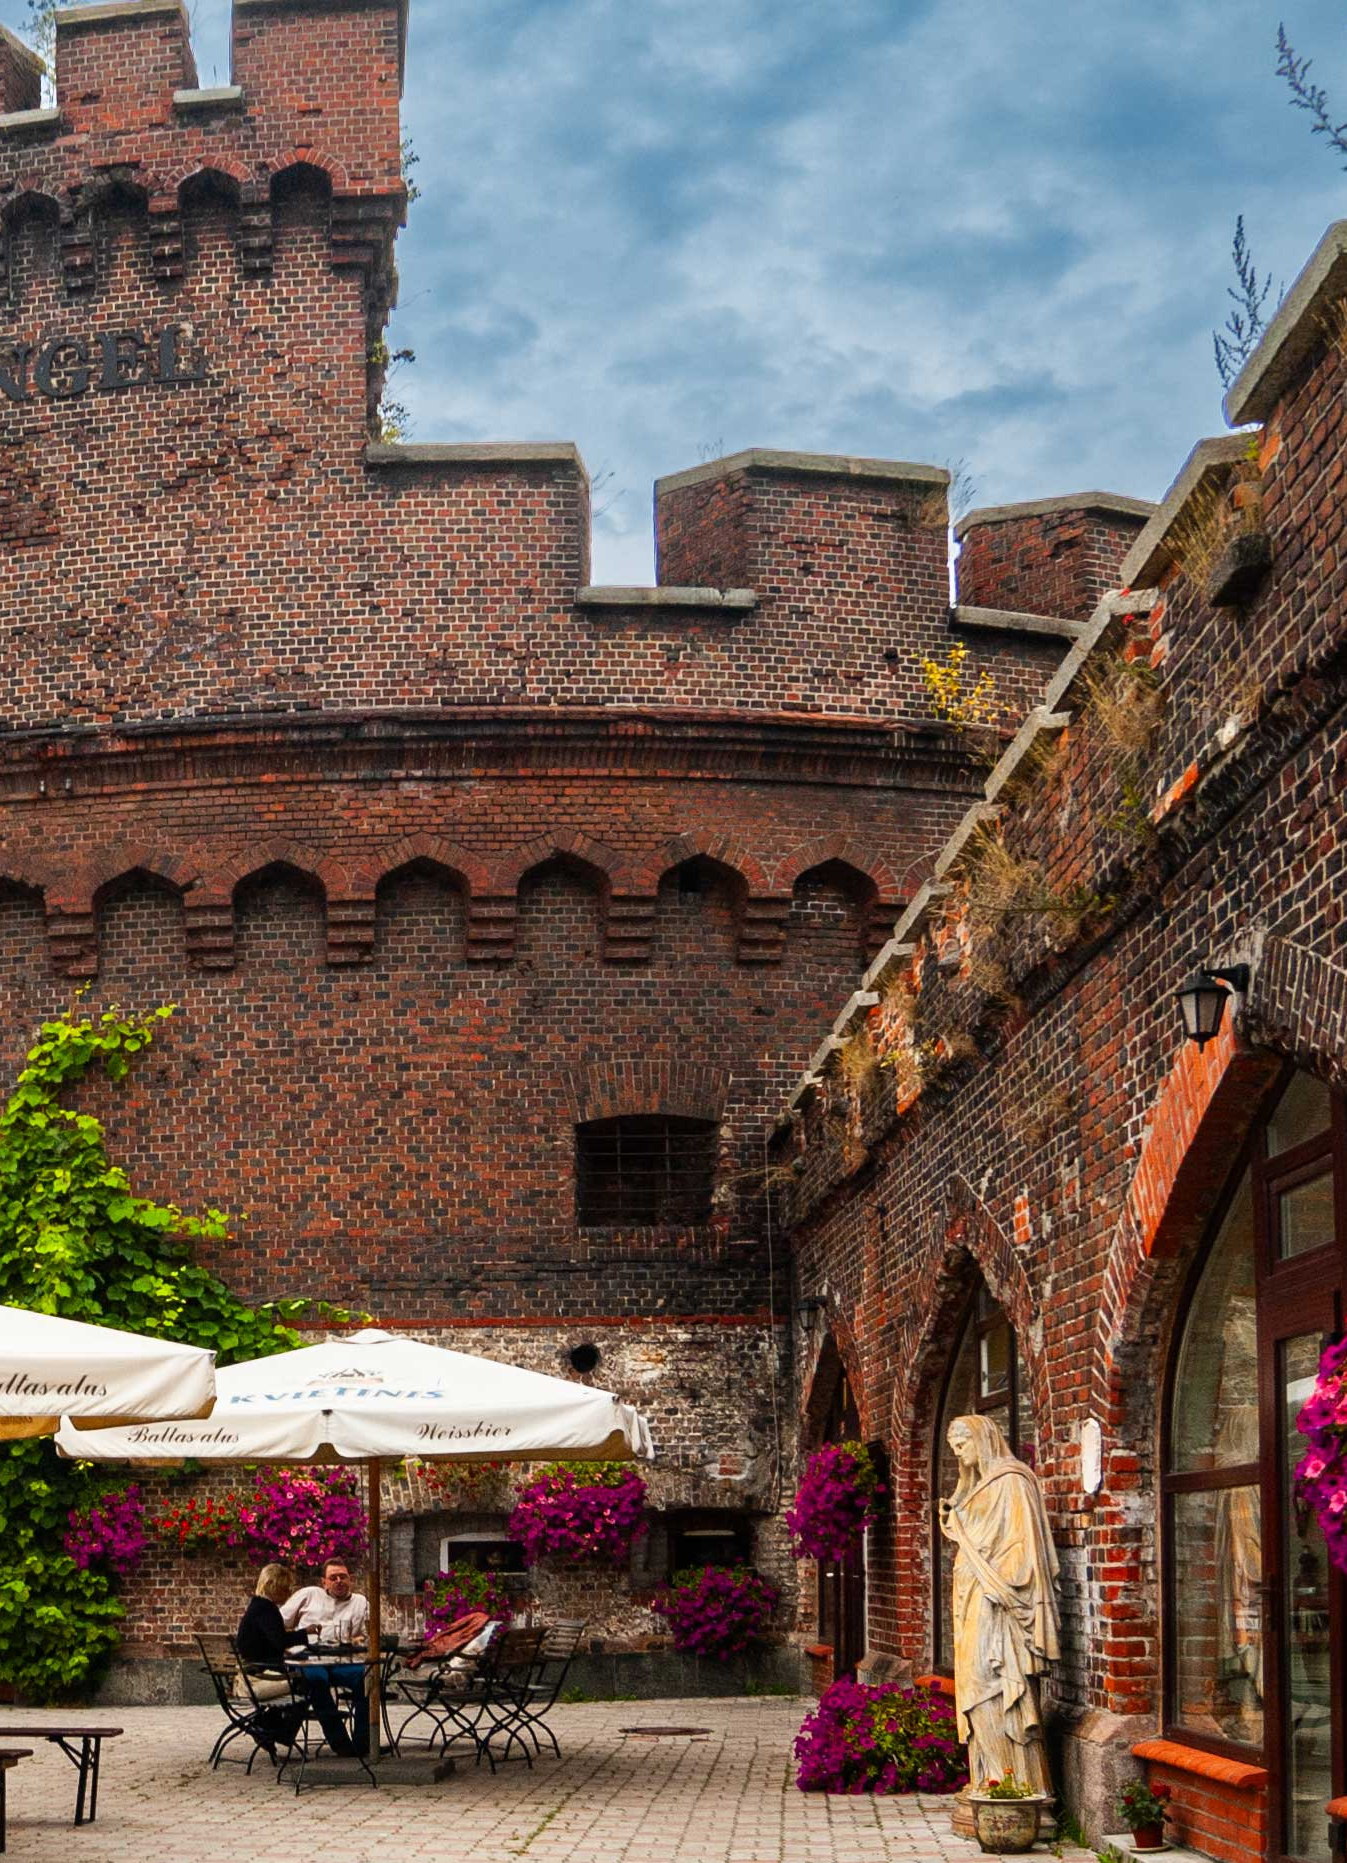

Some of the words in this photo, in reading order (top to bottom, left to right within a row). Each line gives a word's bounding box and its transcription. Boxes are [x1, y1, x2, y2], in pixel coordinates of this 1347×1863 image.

[56, 1373, 108, 1397] alus
[229, 1386, 447, 1405] KVIETINIS
[127, 1426, 196, 1444] Baltas
[197, 1427, 241, 1444] alus
[416, 1420, 516, 1442] Weissbier
